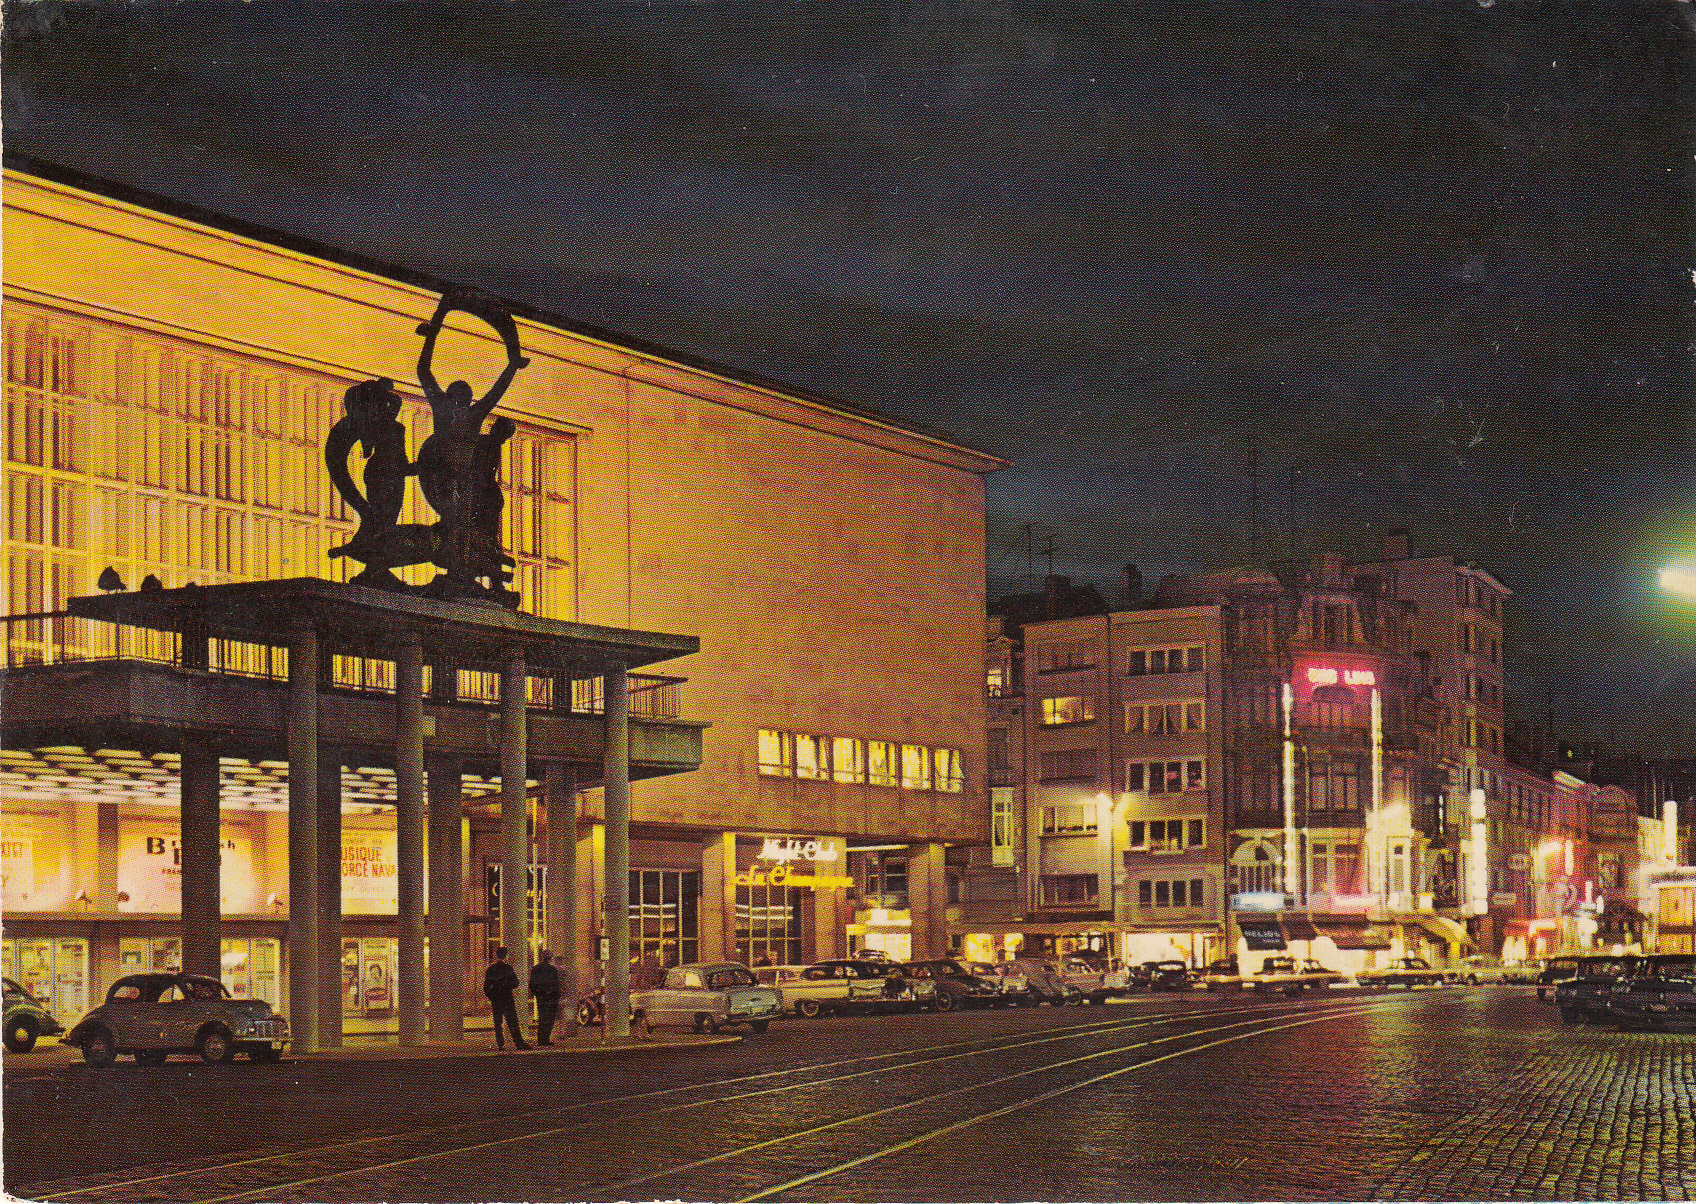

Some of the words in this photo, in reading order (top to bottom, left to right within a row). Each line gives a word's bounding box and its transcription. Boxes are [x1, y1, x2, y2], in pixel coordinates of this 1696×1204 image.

[341, 847, 382, 862] USIQUE
[341, 862, 369, 878] ORCE
[371, 863, 397, 878] NAVA
